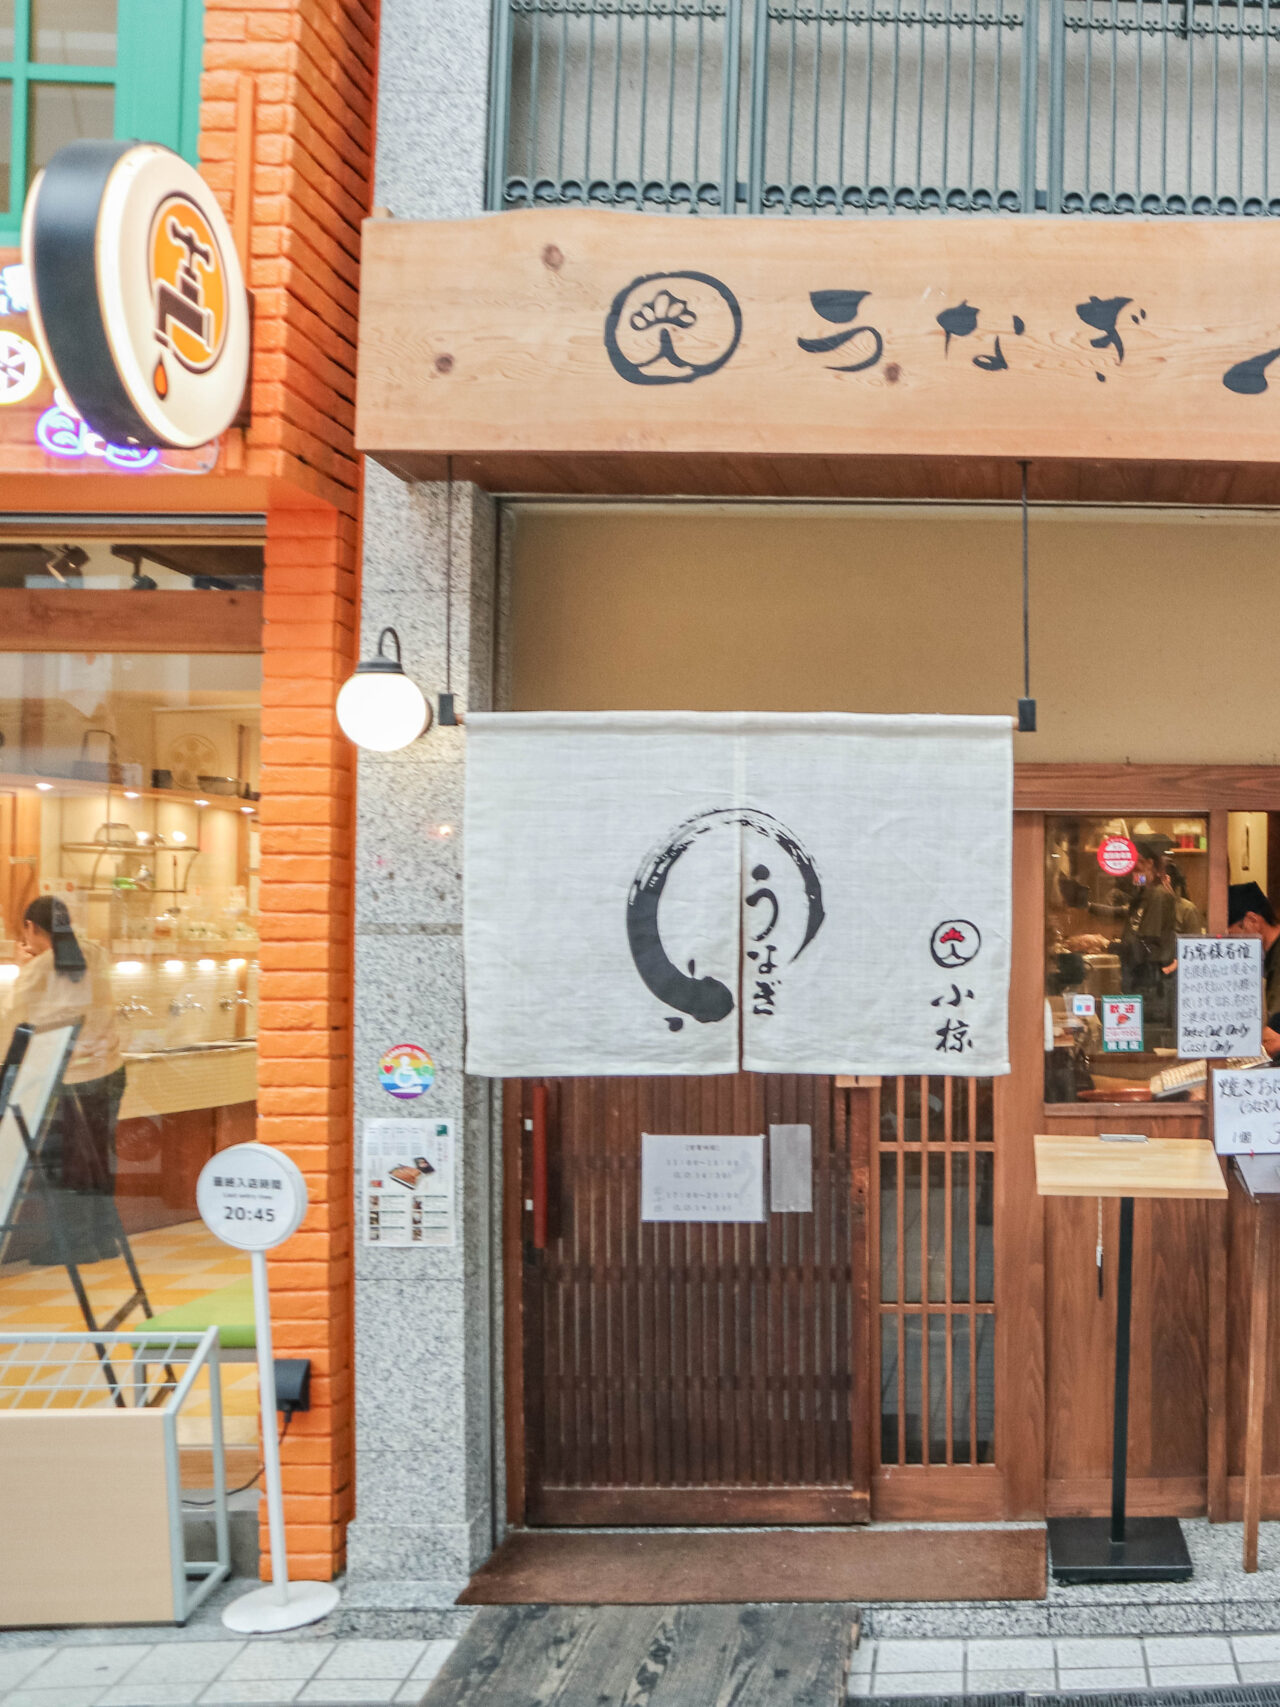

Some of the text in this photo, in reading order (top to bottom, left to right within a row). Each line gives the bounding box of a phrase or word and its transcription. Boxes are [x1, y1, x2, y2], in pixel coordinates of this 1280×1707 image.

[745, 864, 783, 1015] うなぎ
[931, 984, 974, 1053] 小椋
[213, 1176, 282, 1190] 最終入店時間
[224, 1206, 276, 1222] 20:45
